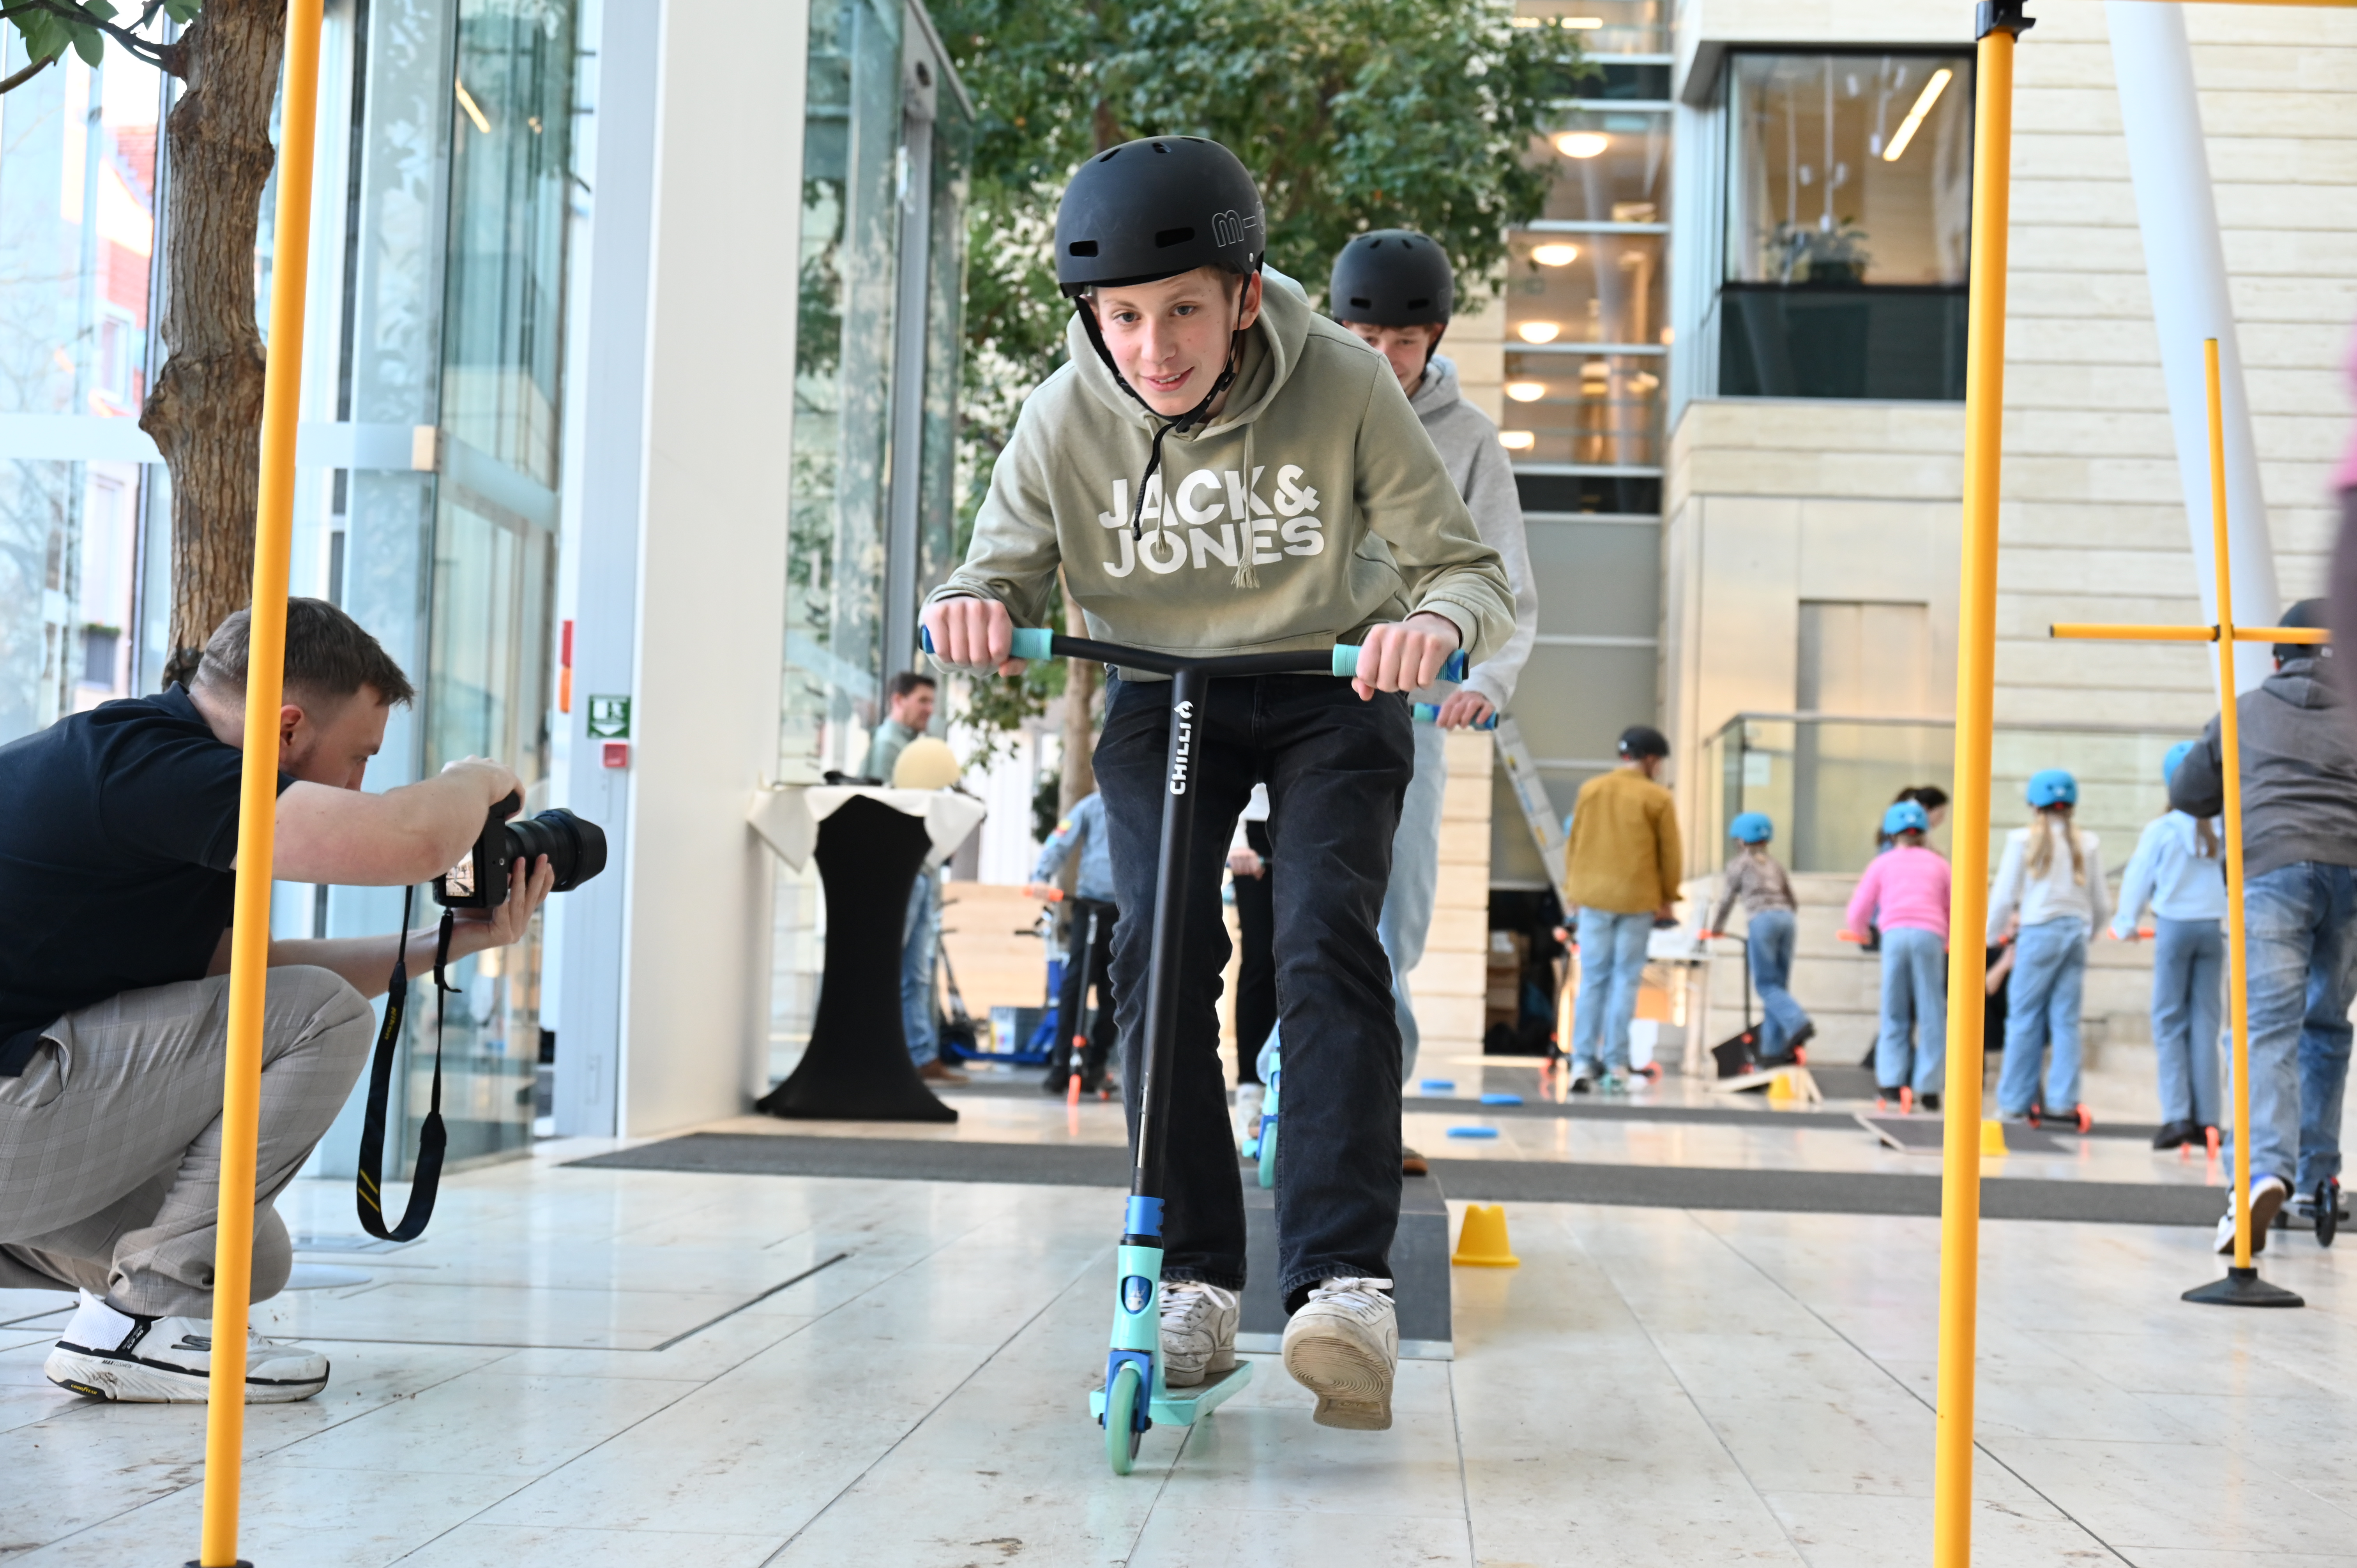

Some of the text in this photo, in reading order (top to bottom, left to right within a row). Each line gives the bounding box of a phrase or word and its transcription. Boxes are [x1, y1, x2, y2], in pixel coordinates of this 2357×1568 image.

[1103, 516, 1324, 577] JONES
[1170, 722, 1192, 795] CHILLI
[385, 1007, 397, 1040] Nikon
[127, 1329, 144, 1349] SLIP-INS
[71, 1384, 97, 1395] GOODYEAR
